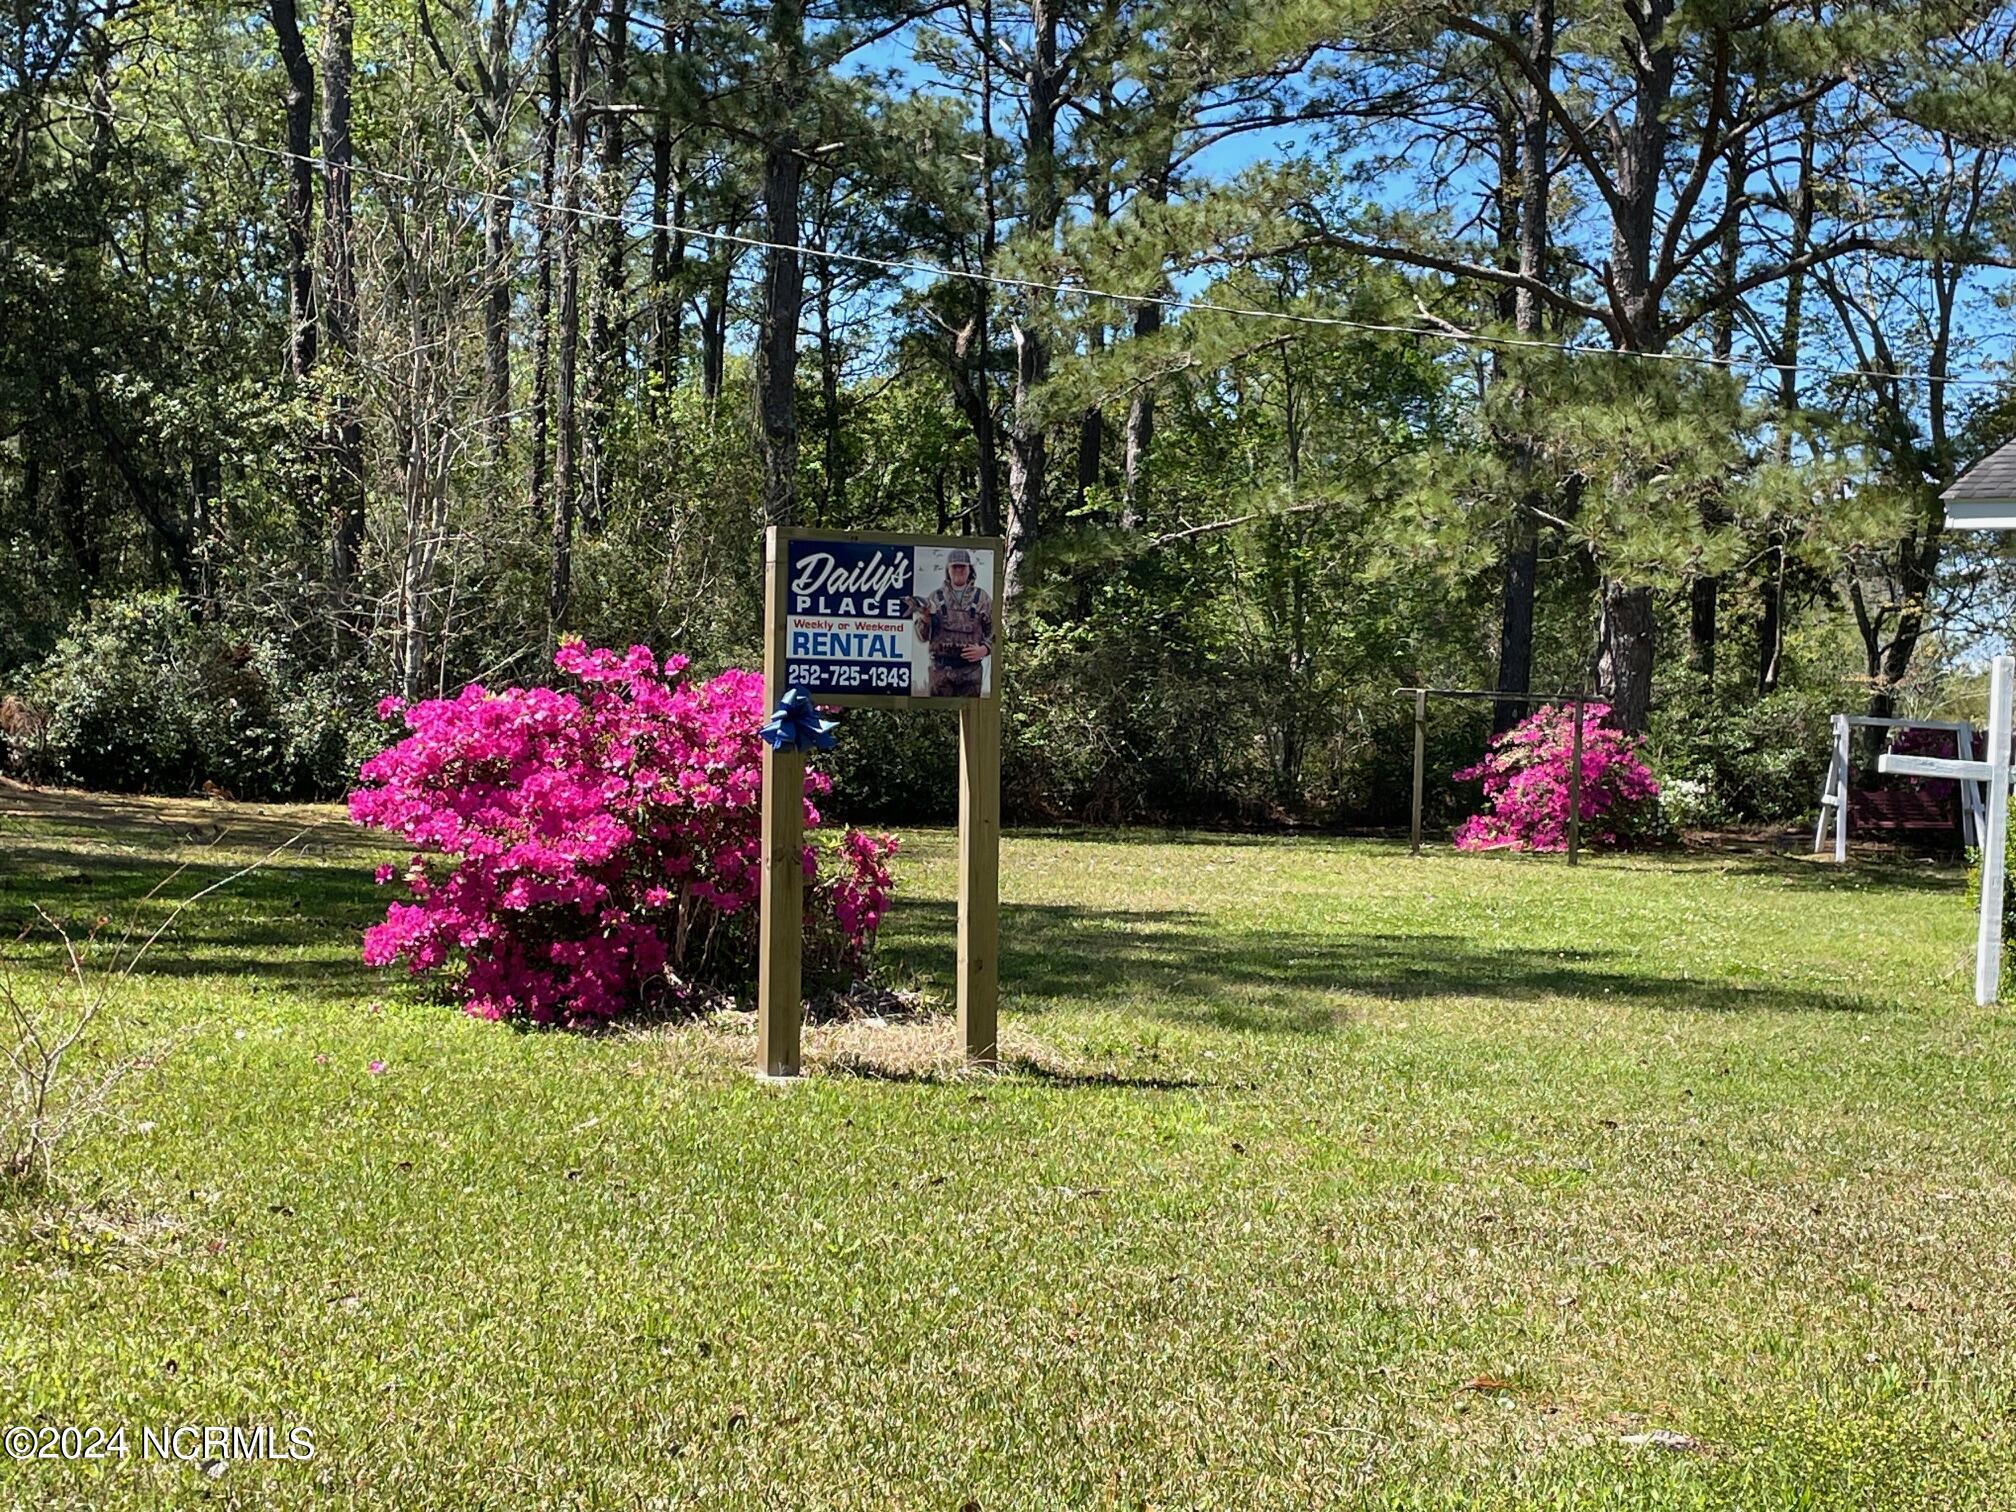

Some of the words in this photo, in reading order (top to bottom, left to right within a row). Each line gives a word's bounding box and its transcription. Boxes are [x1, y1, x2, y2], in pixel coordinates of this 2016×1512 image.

[791, 551, 912, 601] Daily's
[796, 596, 901, 616] PLACE
[793, 619, 833, 631] Weekly
[854, 622, 904, 632] Weekend
[792, 631, 904, 659] RENTAL
[788, 664, 910, 687] 252-725-1343
